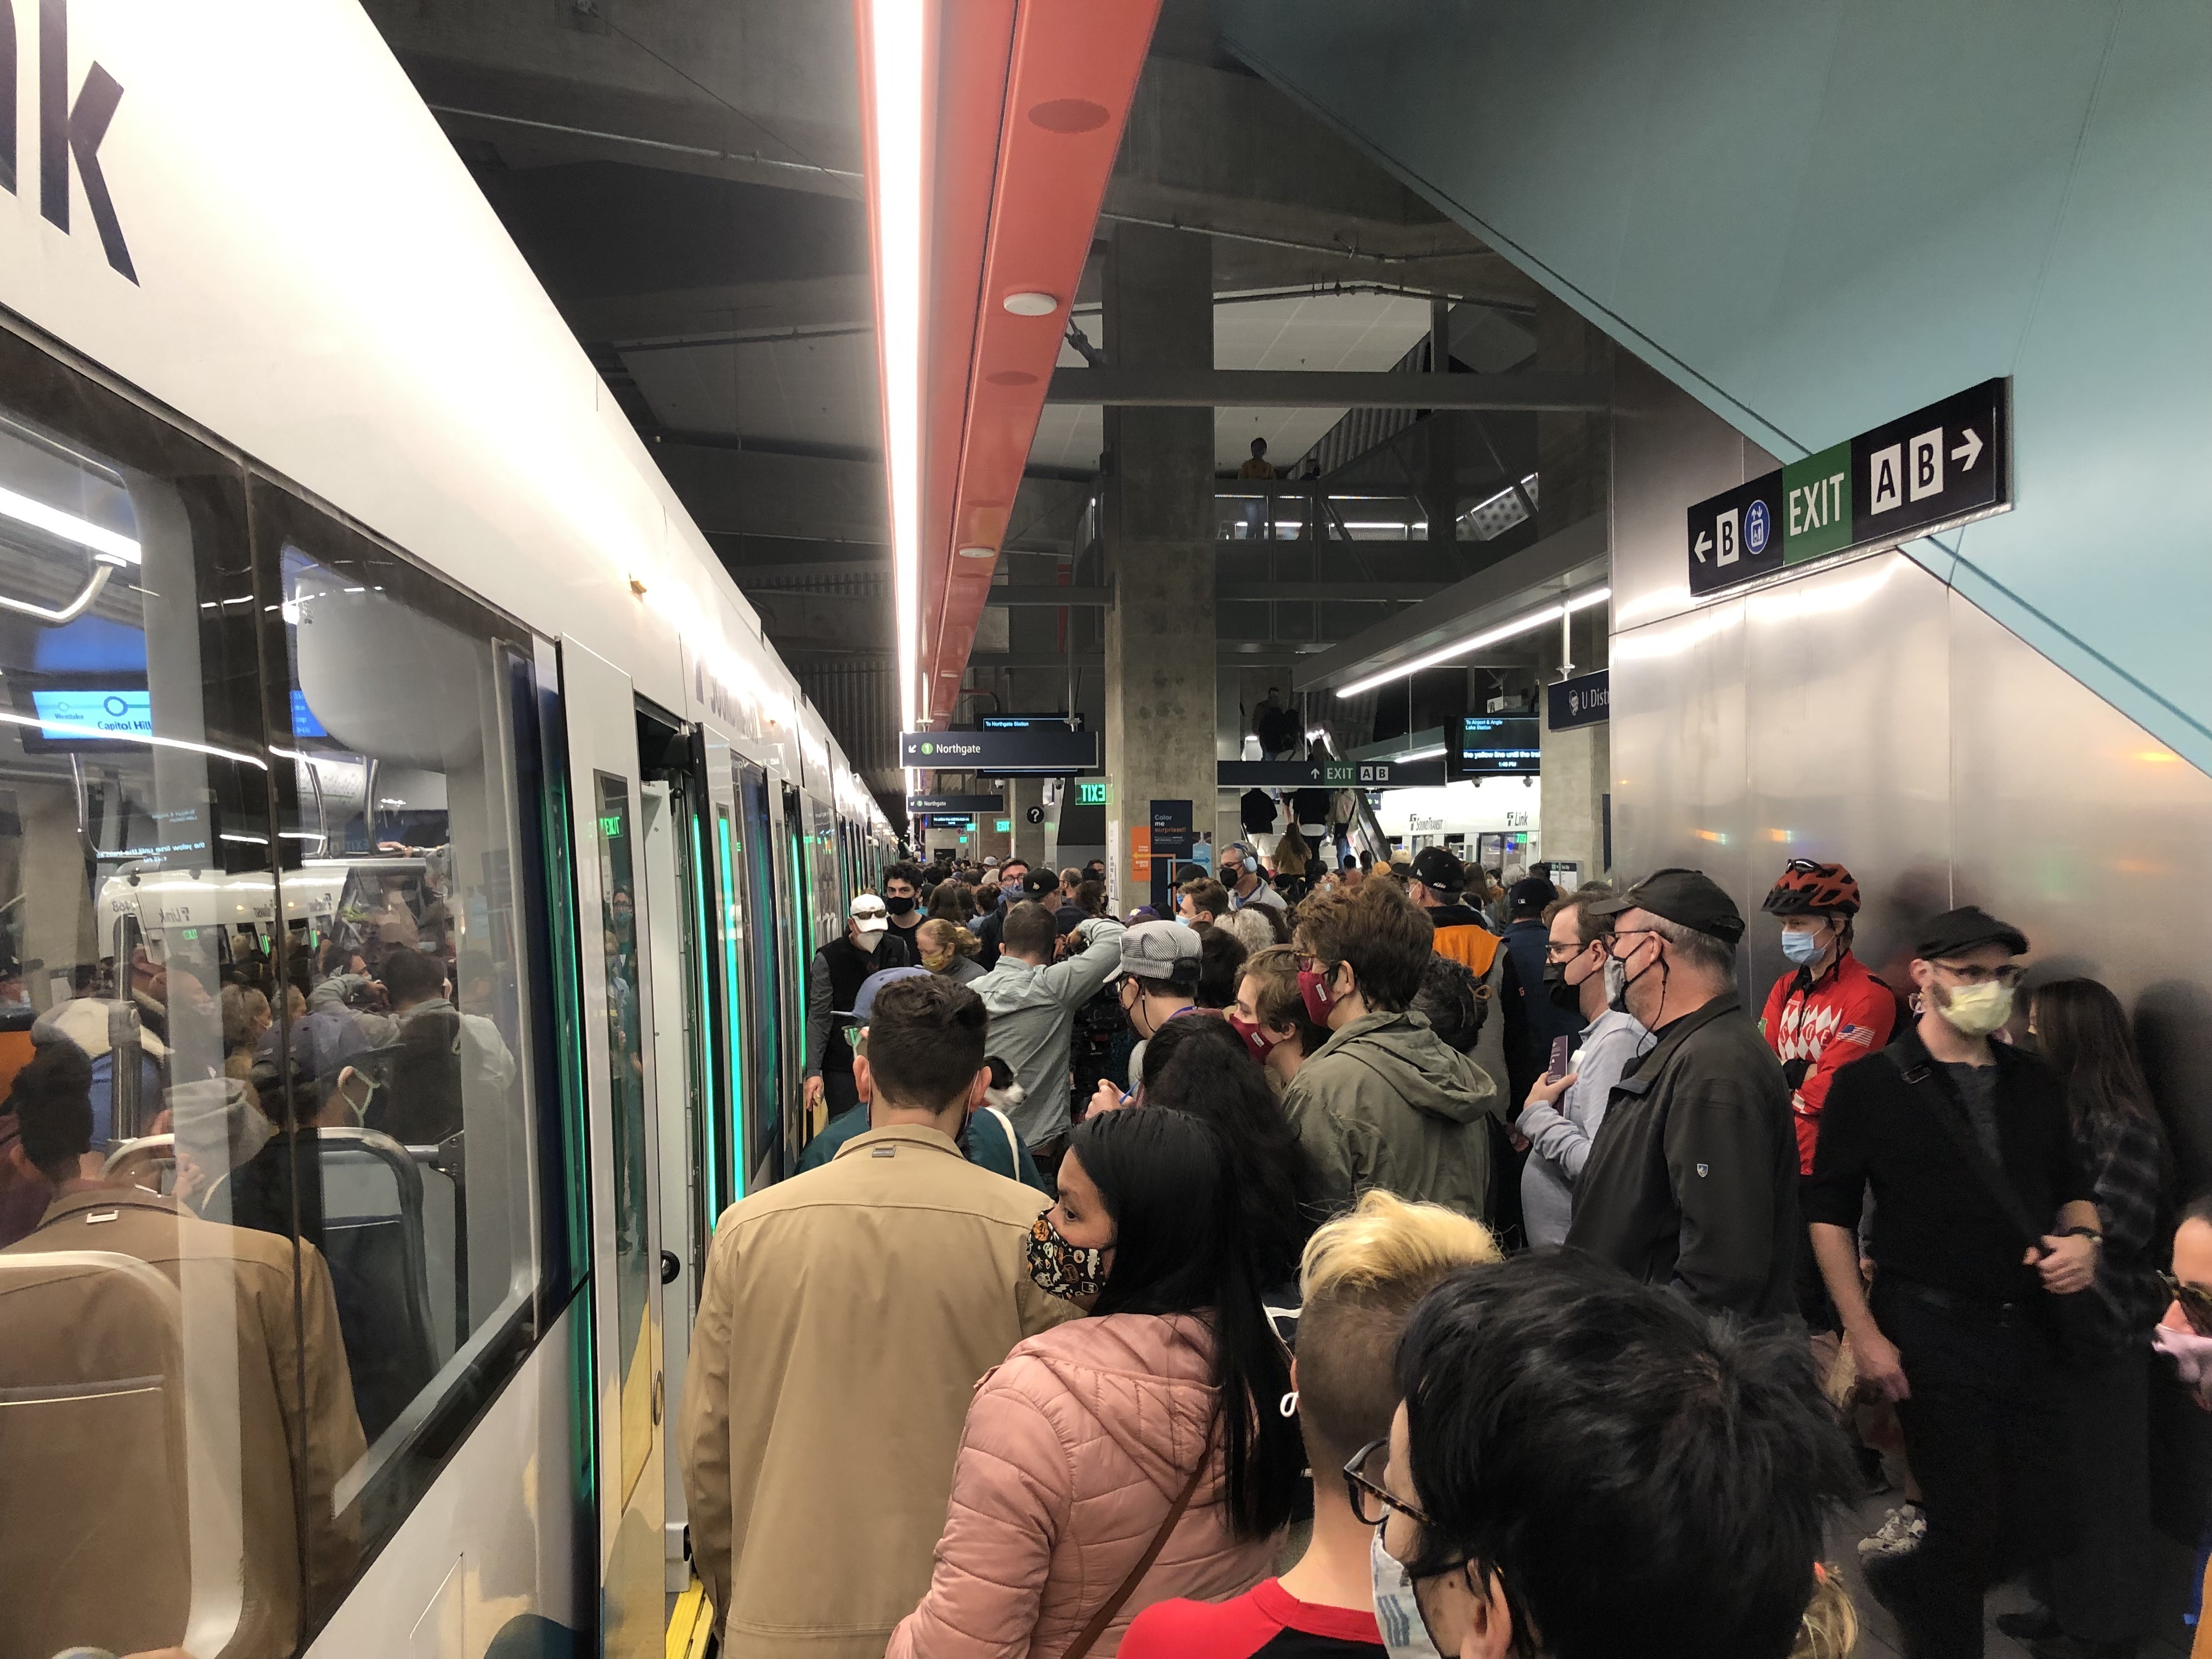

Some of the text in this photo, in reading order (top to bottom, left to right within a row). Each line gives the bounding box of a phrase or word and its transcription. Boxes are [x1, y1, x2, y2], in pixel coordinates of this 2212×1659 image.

[1722, 442, 1935, 557] B EXIT A B
[1582, 691, 1588, 709] U
[97, 720, 132, 731] Capitol
[936, 743, 981, 755] Northgate
[1327, 768, 1353, 779] EXIT
[1515, 811, 1528, 826] Link
